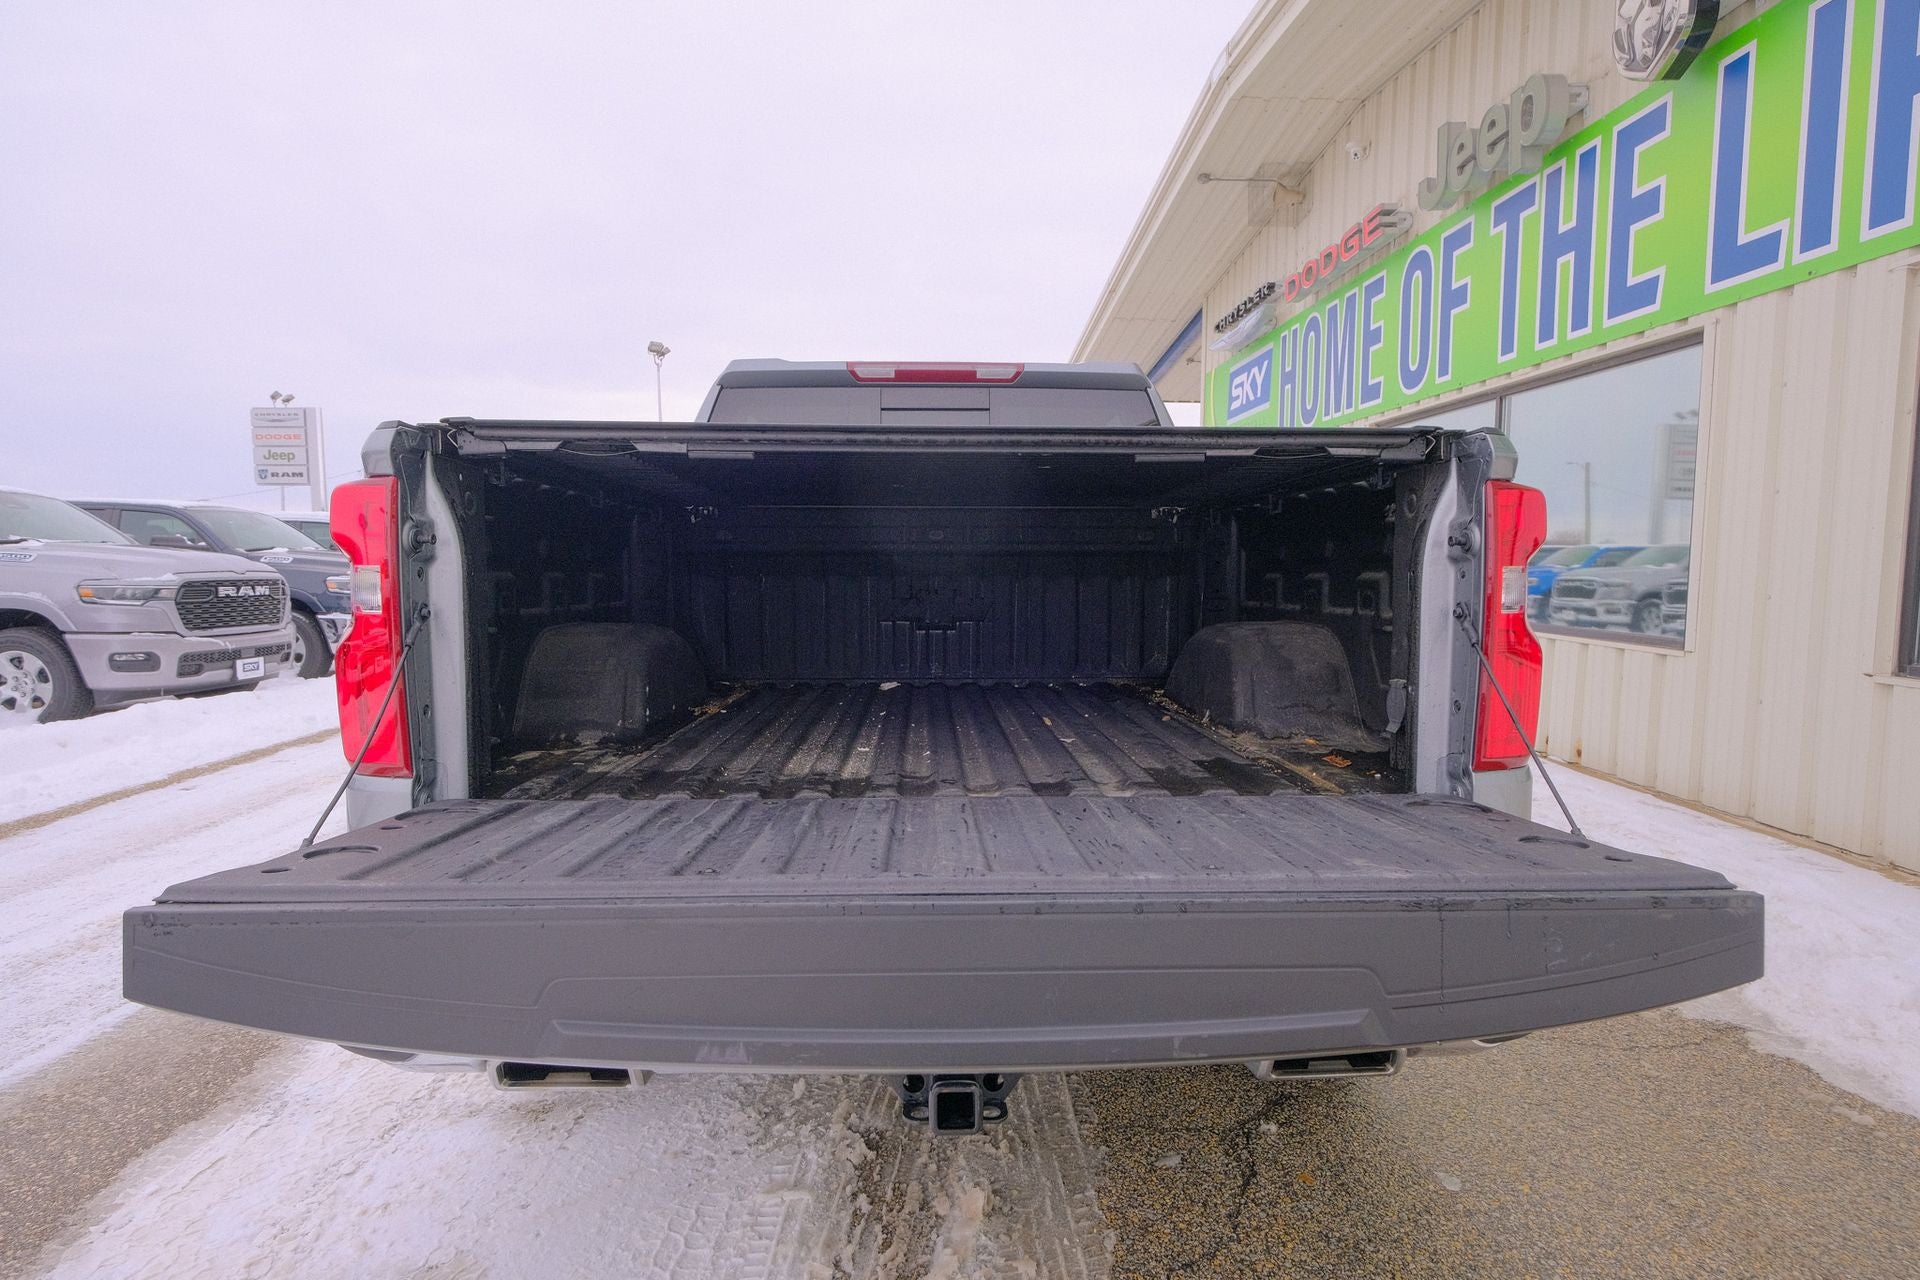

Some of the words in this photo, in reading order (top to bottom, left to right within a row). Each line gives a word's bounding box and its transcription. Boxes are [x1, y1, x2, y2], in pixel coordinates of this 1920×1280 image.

[1417, 74, 1567, 211] Jeep
[1277, 269, 1387, 428] HOME
[1398, 214, 1476, 396] OF
[1490, 90, 1674, 364] THE
[1284, 205, 1386, 303] DODGE
[1230, 360, 1269, 411] SKY
[263, 449, 296, 463] Jeep
[217, 586, 270, 597] RAM
